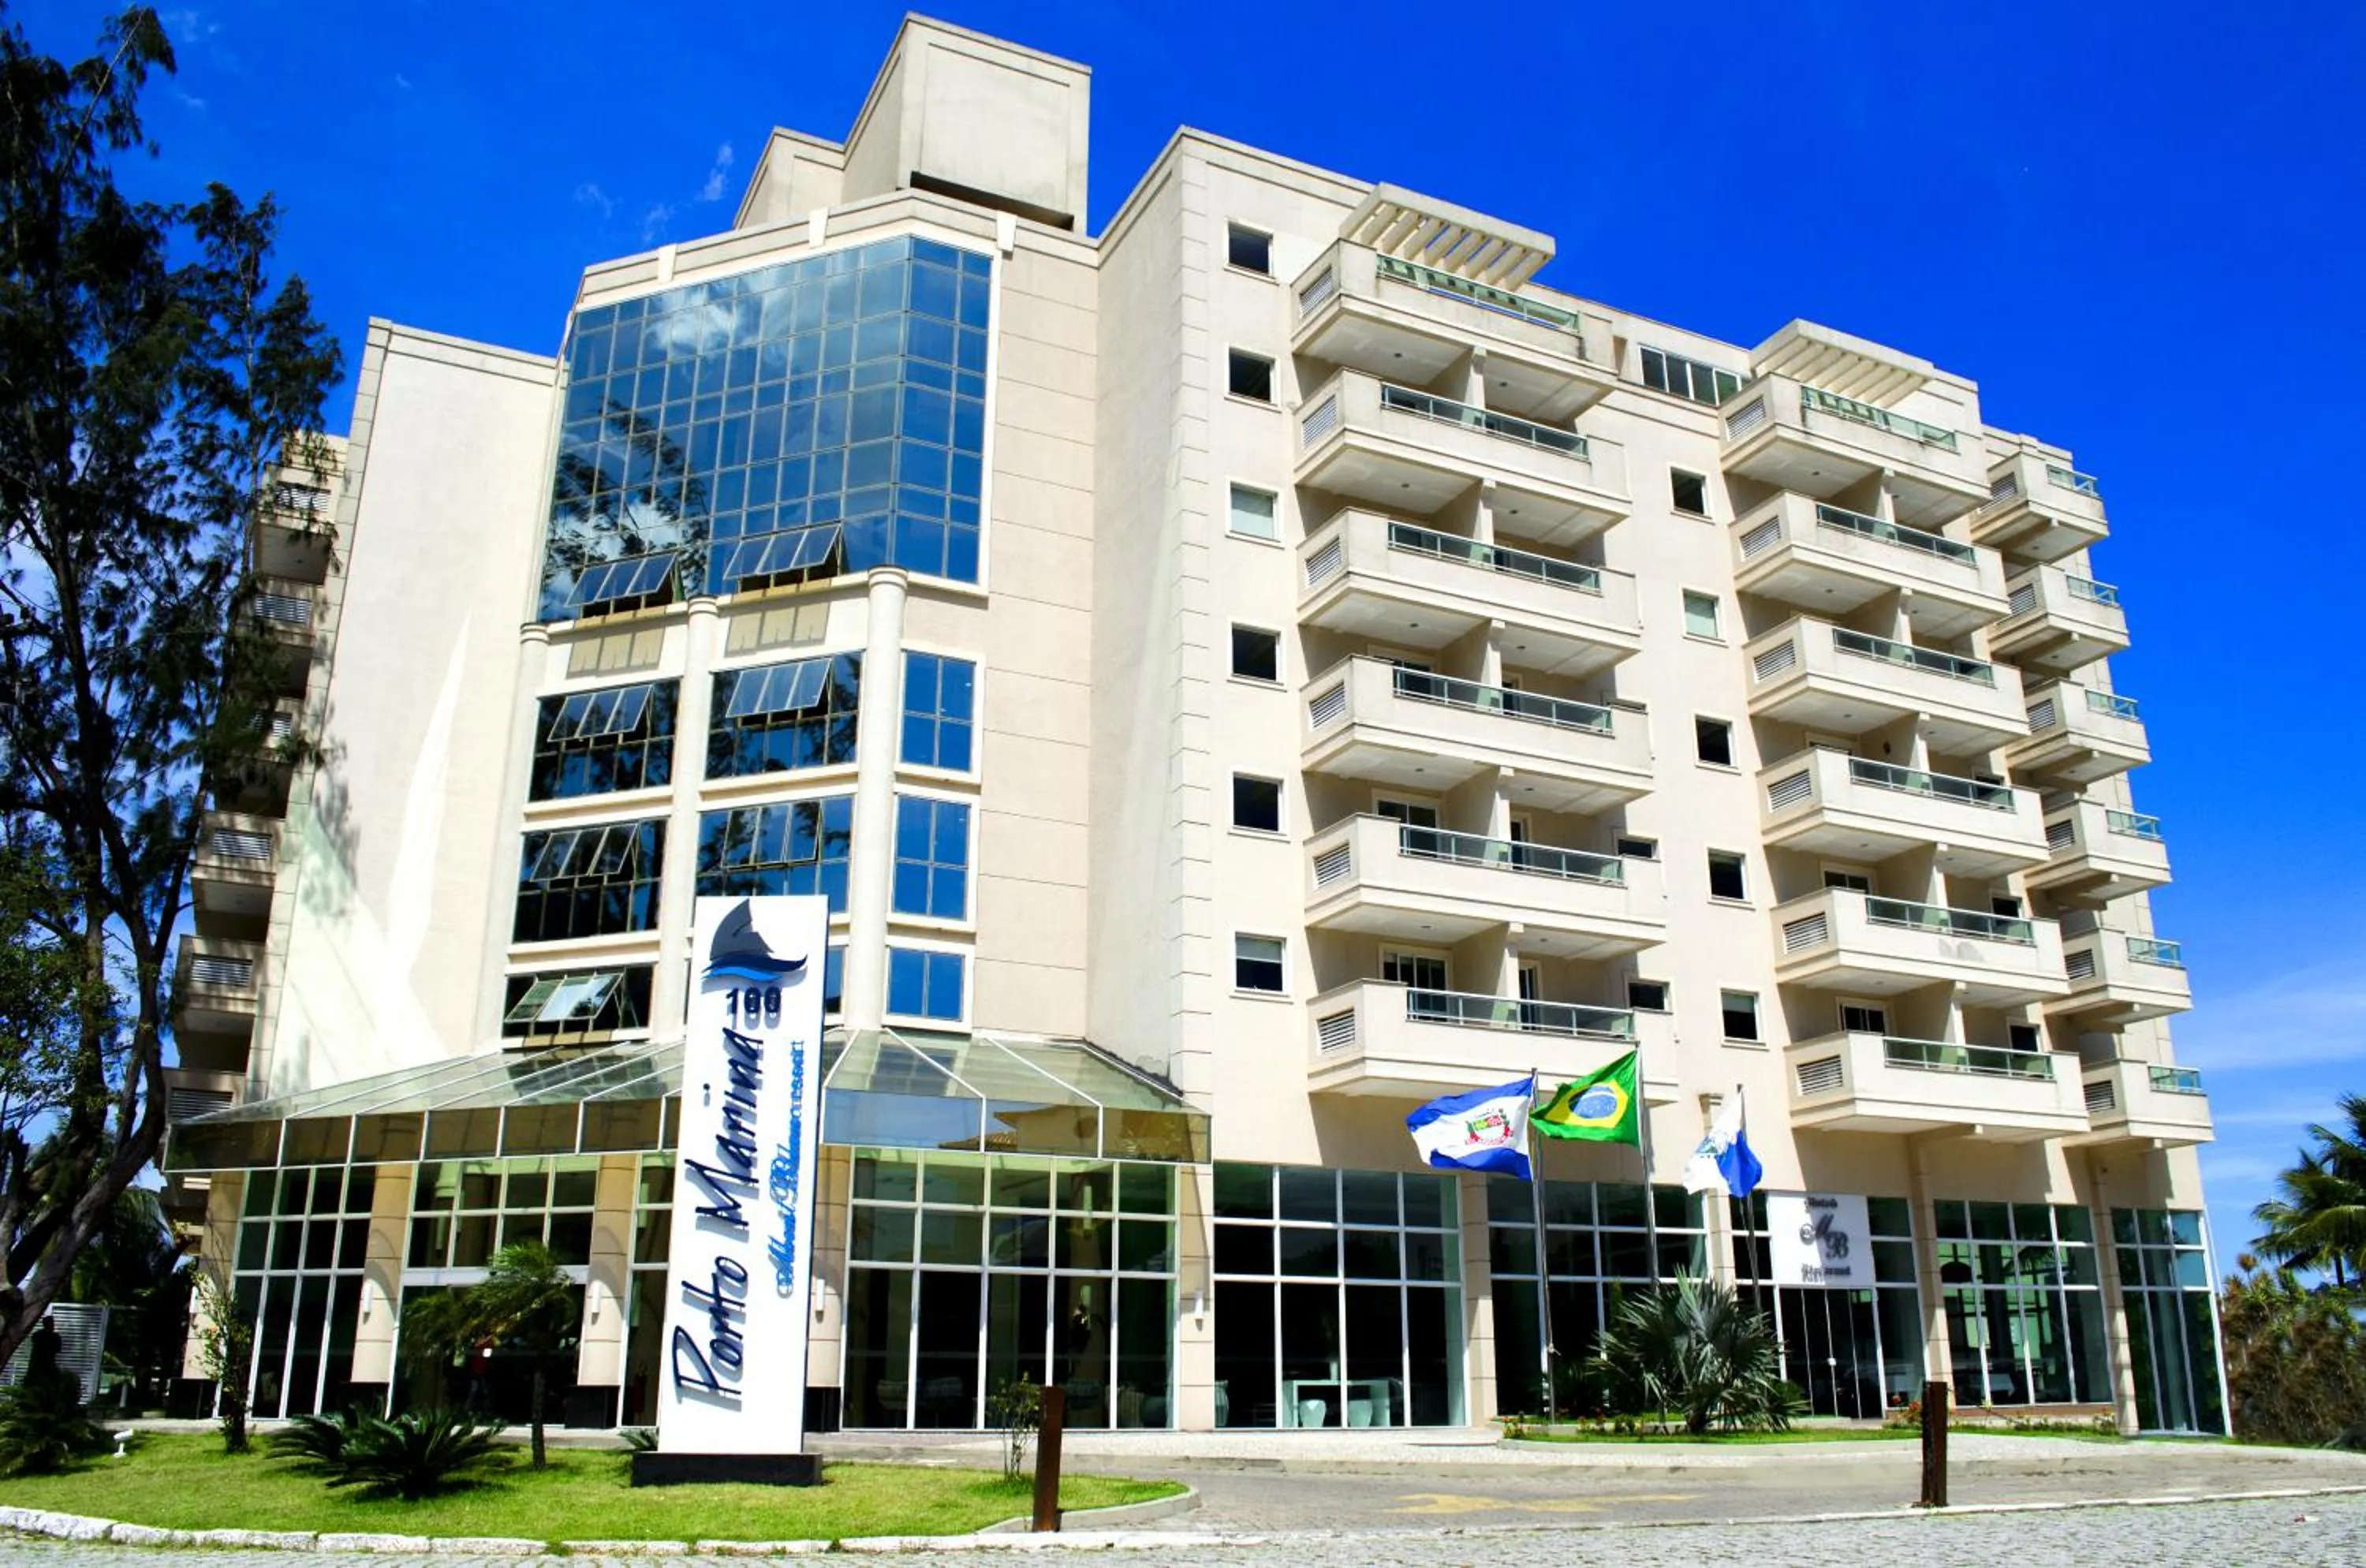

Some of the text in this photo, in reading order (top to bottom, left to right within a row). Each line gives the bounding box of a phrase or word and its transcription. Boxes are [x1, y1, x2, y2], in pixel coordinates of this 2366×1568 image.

[726, 987, 781, 1014] 100
[672, 1026, 763, 1395] Porto Marina
